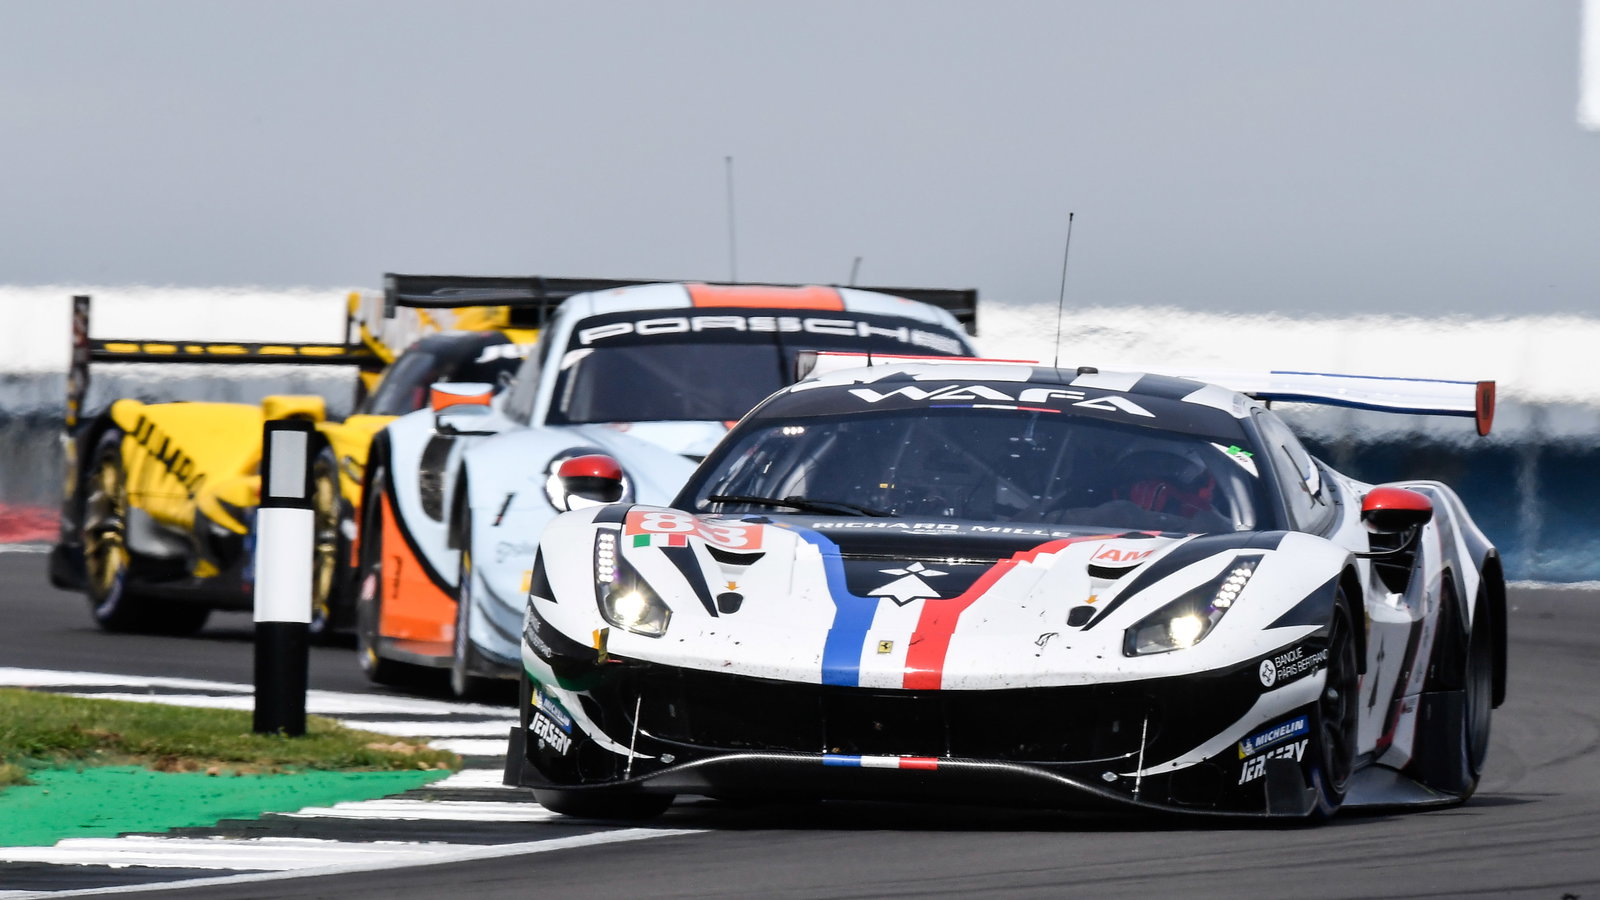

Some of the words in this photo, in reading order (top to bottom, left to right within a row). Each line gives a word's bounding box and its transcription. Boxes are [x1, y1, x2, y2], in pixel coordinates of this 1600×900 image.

[578, 315, 963, 355] PORSCHE
[847, 384, 1156, 418] WAFA
[639, 512, 748, 548] 83
[811, 521, 960, 530] RICHARD
[970, 525, 1072, 538] MILLE
[1097, 548, 1156, 562] AM
[1274, 646, 1304, 668] BANQUE
[1255, 719, 1304, 747] MICHELIN
